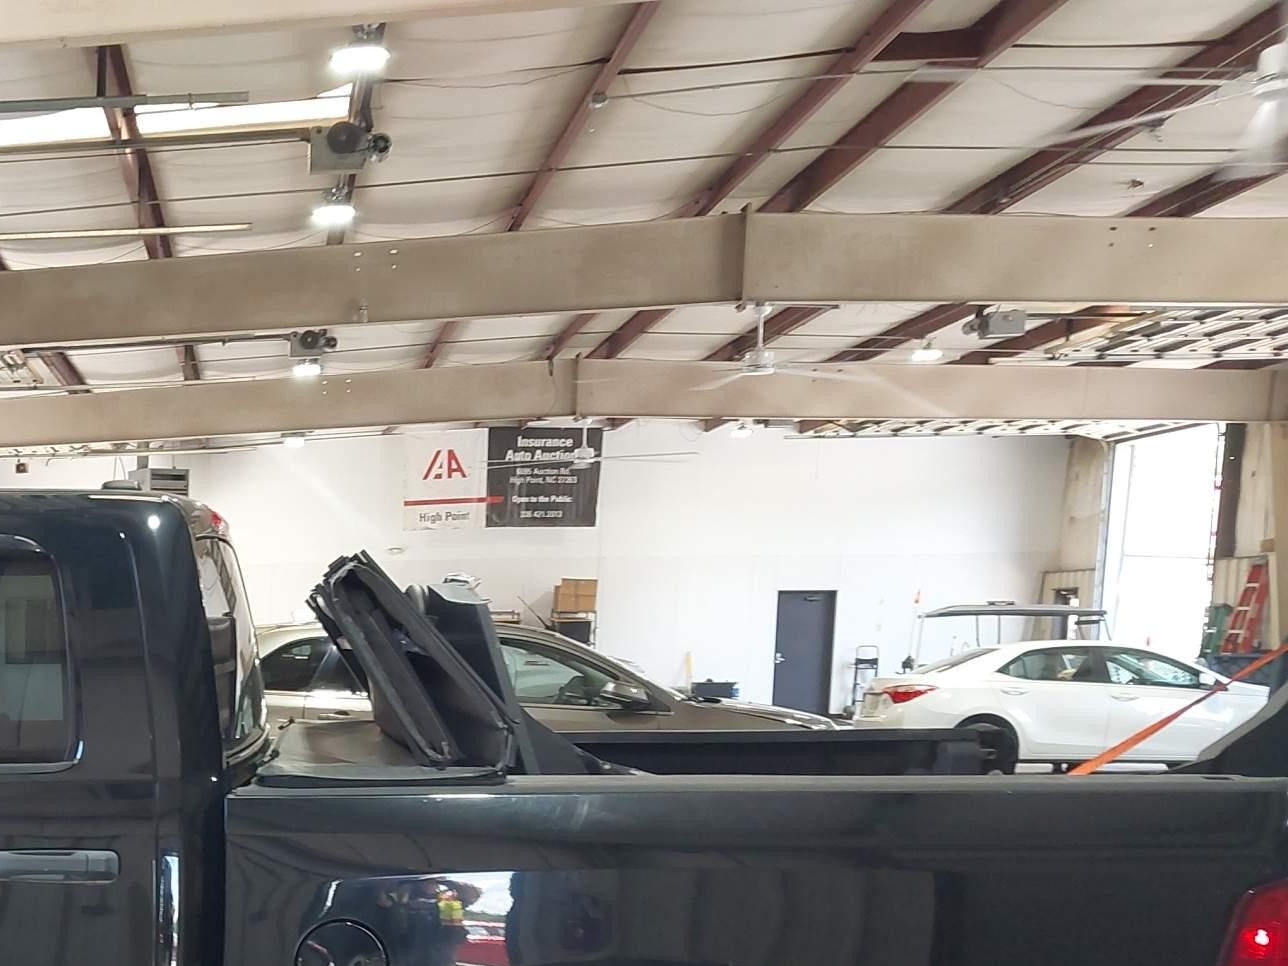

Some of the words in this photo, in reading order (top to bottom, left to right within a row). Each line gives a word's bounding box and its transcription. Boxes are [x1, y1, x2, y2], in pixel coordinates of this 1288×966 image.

[517, 436, 573, 447] Insurance
[505, 449, 532, 461] Auto
[533, 449, 578, 461] Auction
[512, 495, 529, 504] Open
[419, 512, 442, 524] High
[445, 511, 470, 521] Point
